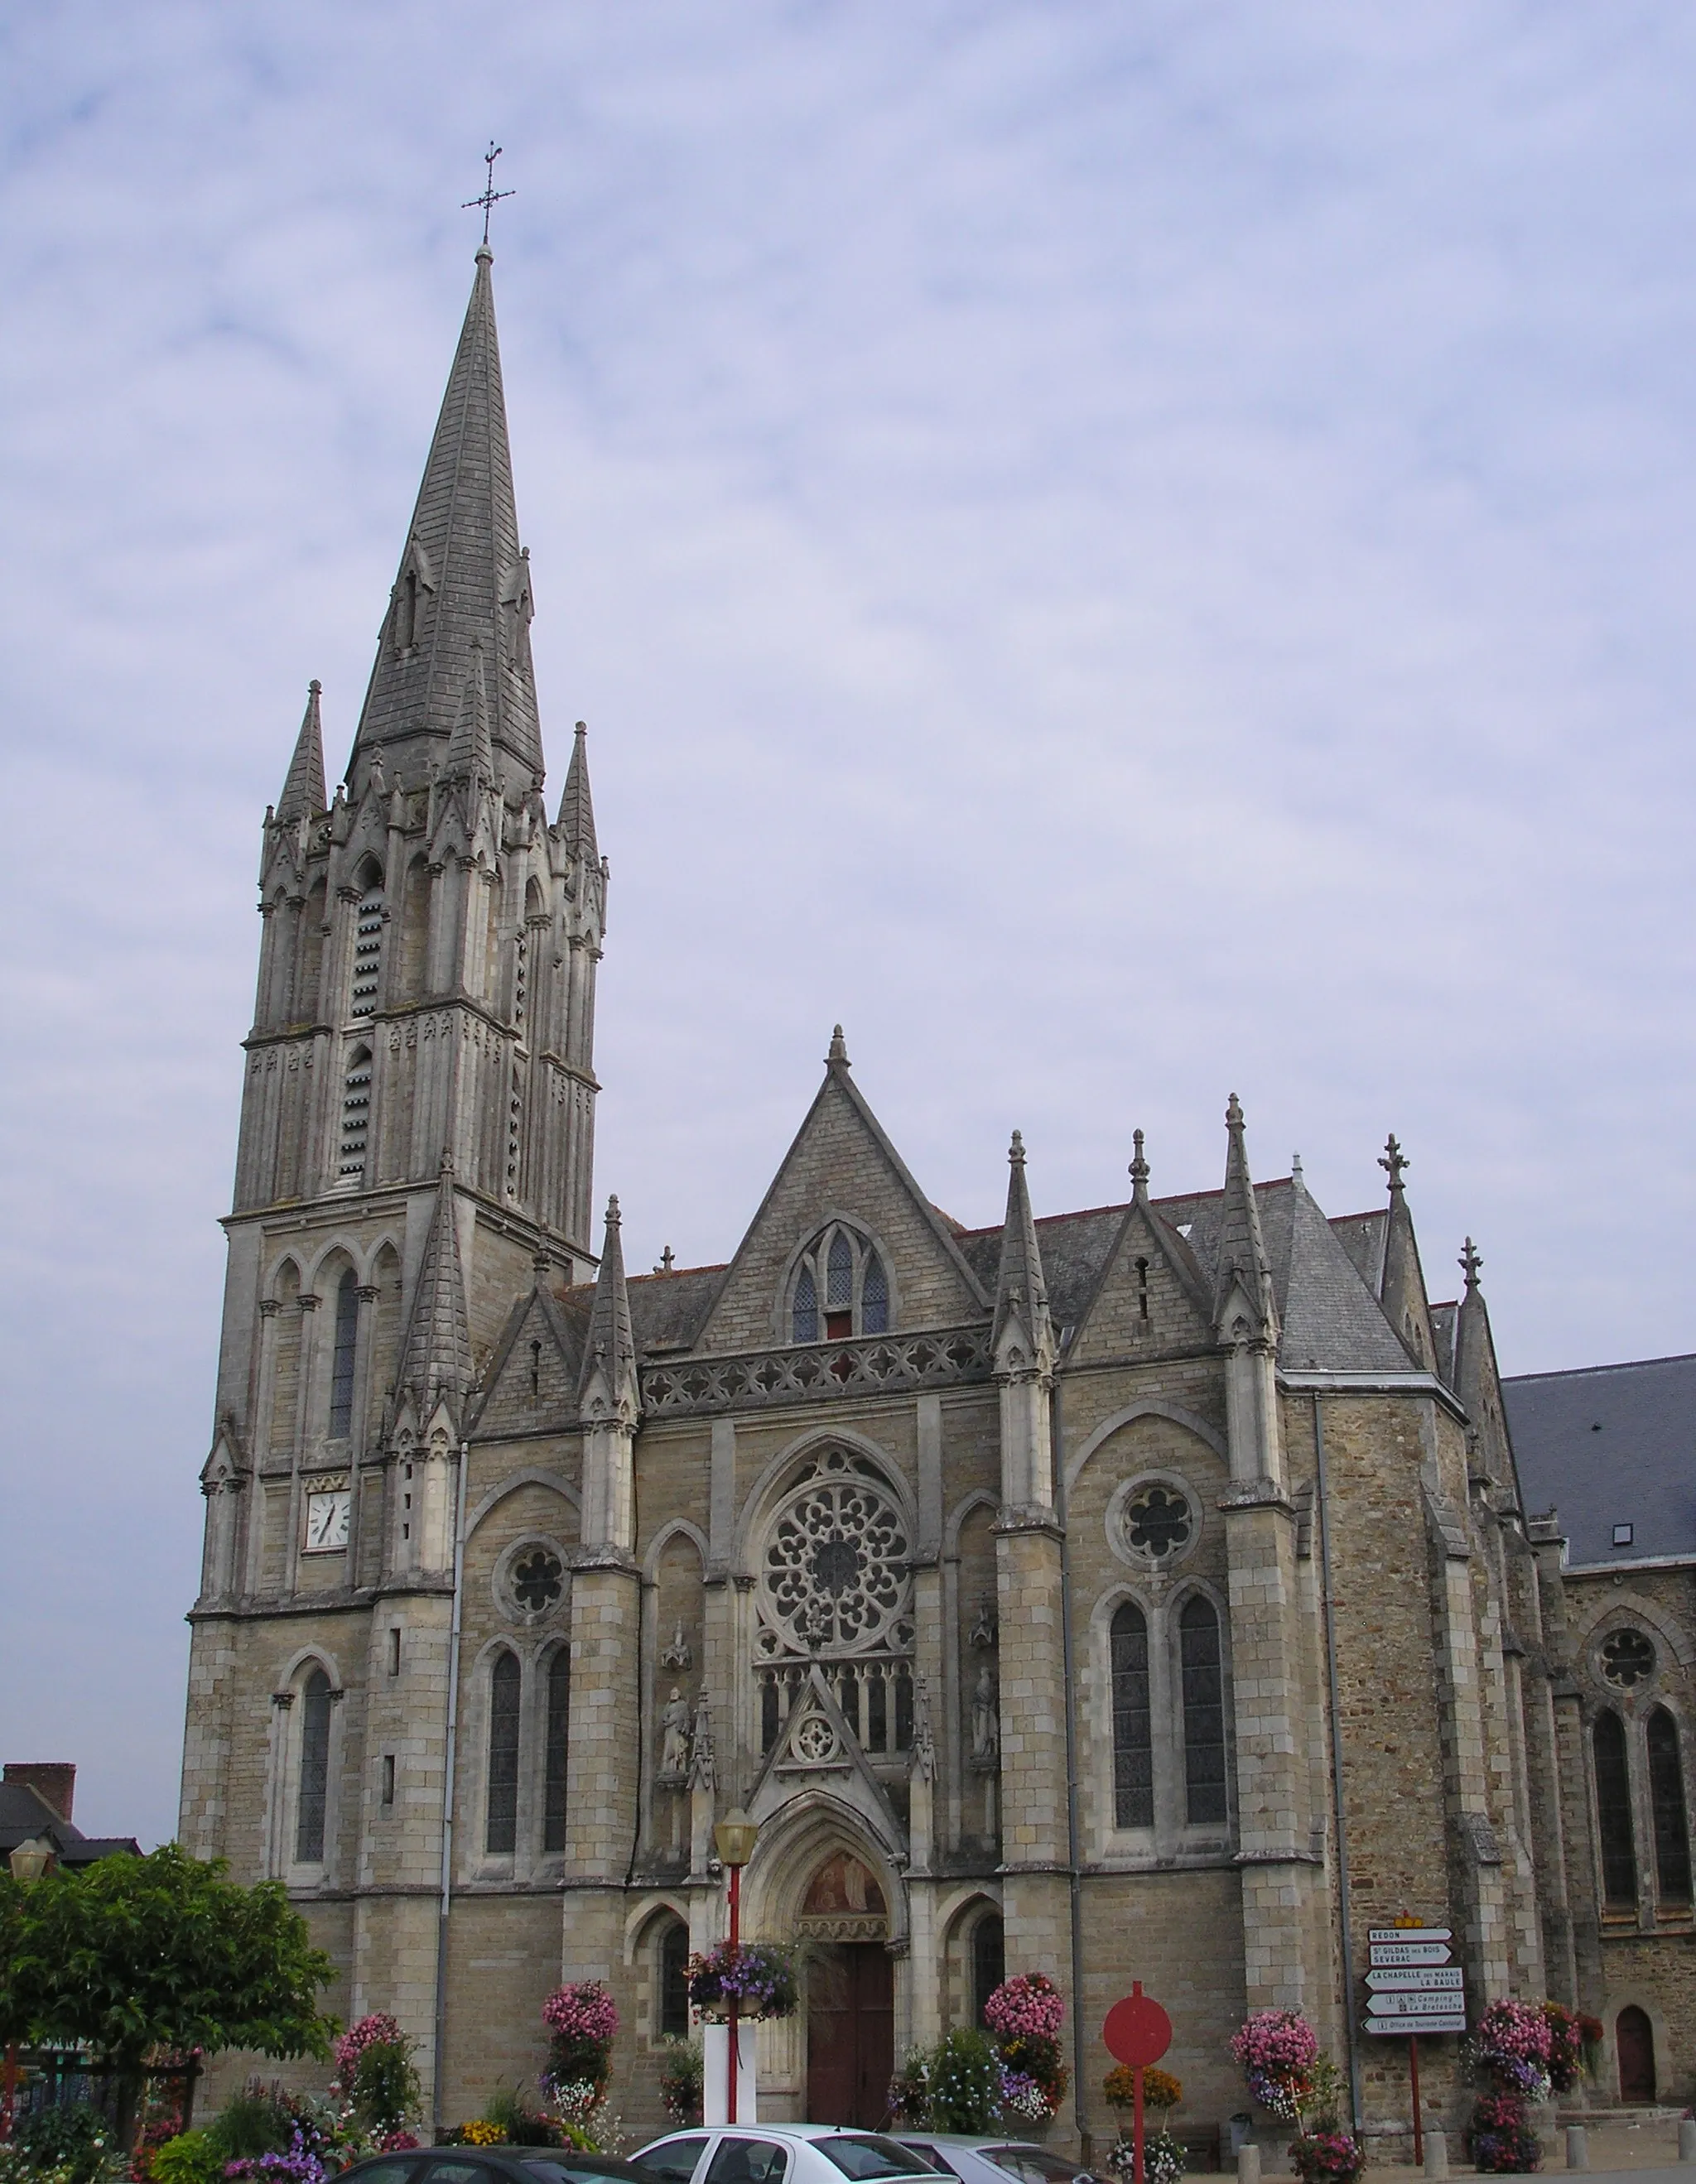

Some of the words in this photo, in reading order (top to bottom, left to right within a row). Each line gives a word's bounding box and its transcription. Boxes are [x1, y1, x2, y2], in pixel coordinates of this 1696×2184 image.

[1383, 1946, 1409, 1955] GILDAS
[1374, 1955, 1410, 1963] SEVERAC
[1383, 1970, 1421, 1979] CHAPELLE
